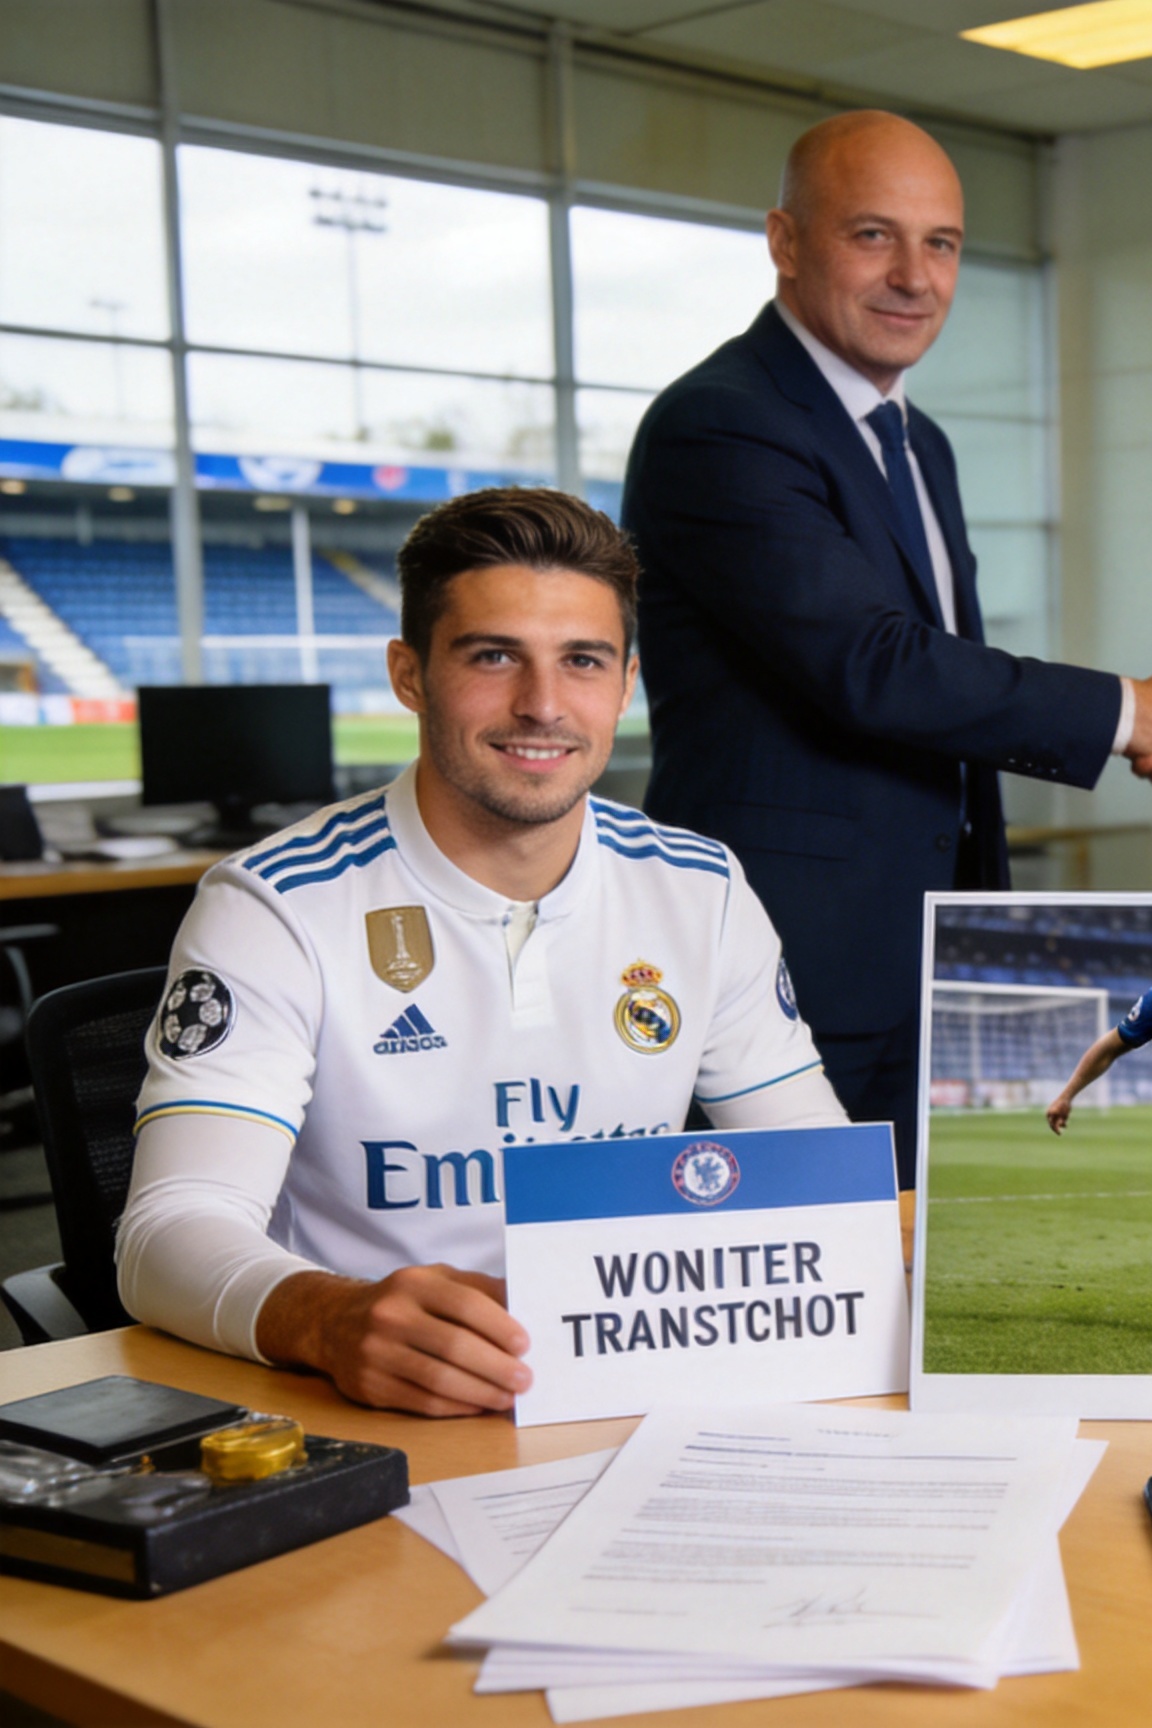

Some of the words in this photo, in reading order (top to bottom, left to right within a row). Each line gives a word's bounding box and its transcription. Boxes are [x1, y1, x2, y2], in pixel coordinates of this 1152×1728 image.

[493, 1078, 580, 1132] Fly
[593, 1241, 823, 1298] WONITER
[561, 1291, 865, 1357] TRANSTCHOT
